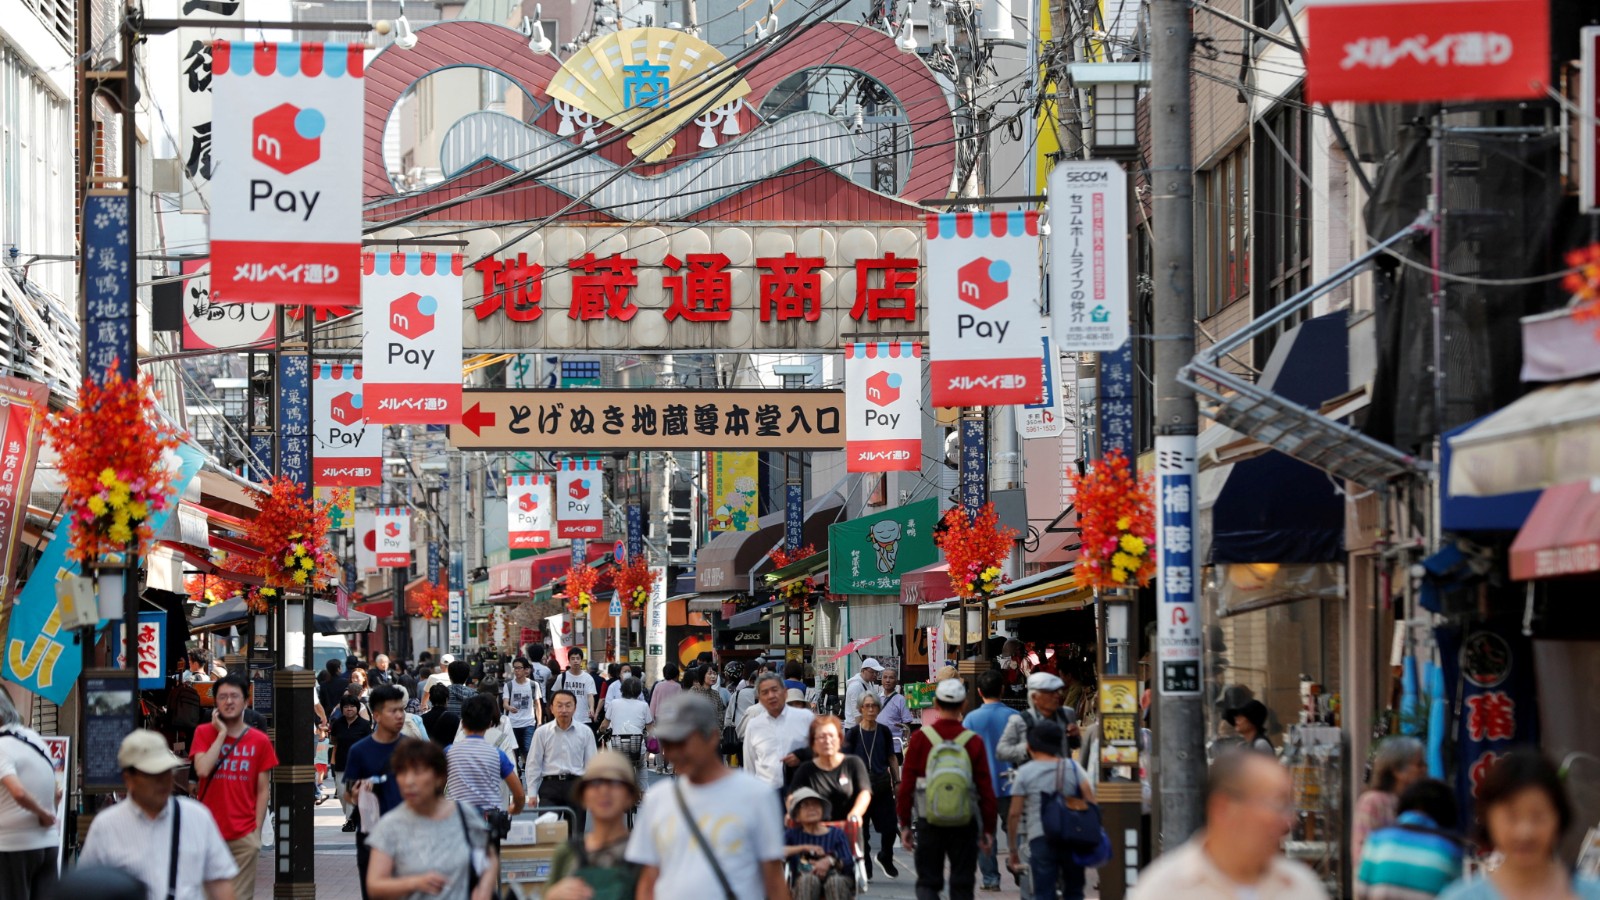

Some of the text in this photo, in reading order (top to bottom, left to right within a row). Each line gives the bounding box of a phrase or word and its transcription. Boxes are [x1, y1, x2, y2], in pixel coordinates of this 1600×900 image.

[1339, 31, 1513, 69] メルペイ通り
[622, 59, 670, 109] 商
[1066, 171, 1108, 182] SECOM
[249, 179, 321, 222] Pay
[1070, 193, 1085, 323] セコムホームライフの仲介
[232, 262, 339, 286] メルペイ通り
[957, 313, 1010, 343] Pay
[388, 342, 435, 370] Pay
[947, 374, 1027, 391] メルペイ通り
[377, 397, 448, 412] メルペイ通り
[508, 402, 841, 437] とげぬき地蔵尊本堂入口
[865, 409, 900, 429] Pay
[329, 428, 363, 448] Pay
[858, 449, 911, 462] メルペイ通り
[321, 466, 372, 478] メルペイ通り
[568, 501, 590, 514] Pay
[518, 513, 538, 525] Pay
[384, 538, 401, 548] Pay
[1163, 483, 1192, 595] 補聴器
[743, 632, 761, 640] asics
[1103, 717, 1135, 729] FREE
